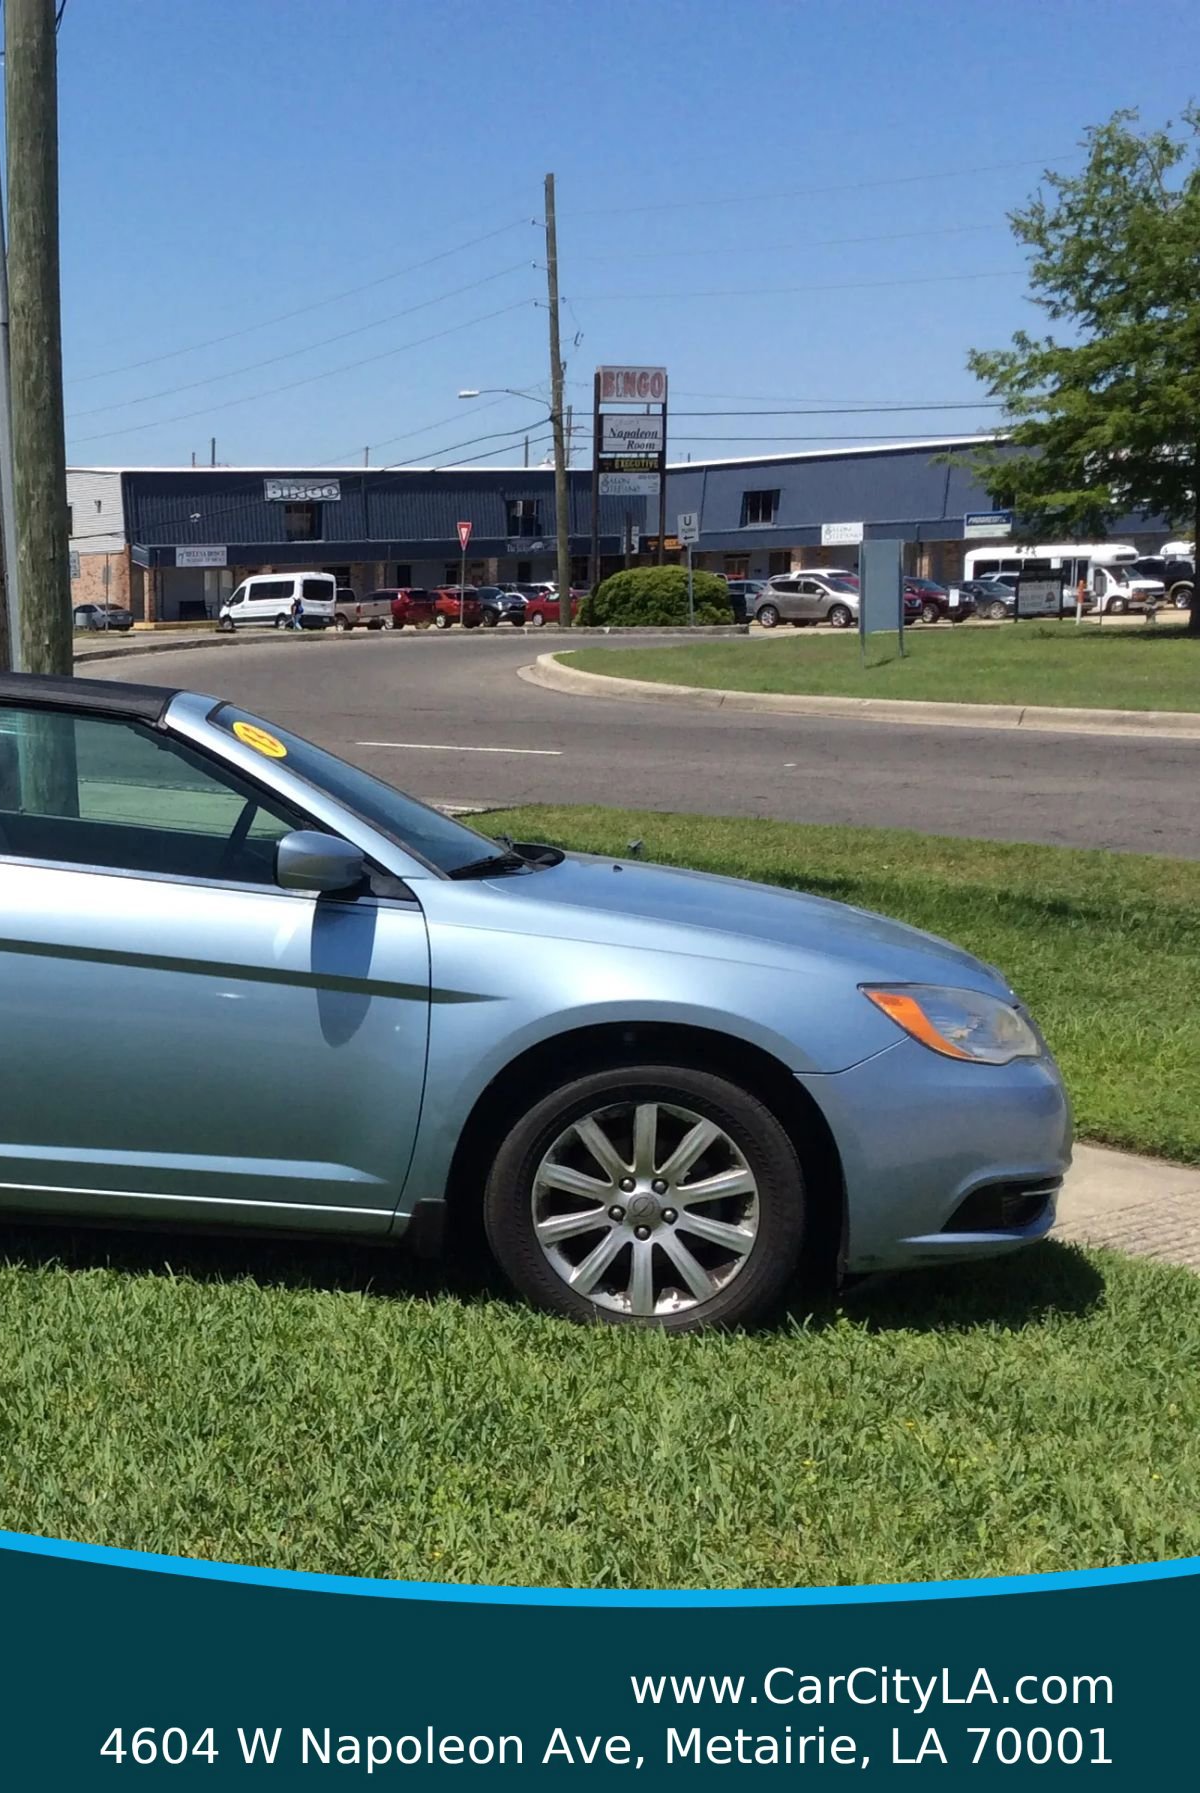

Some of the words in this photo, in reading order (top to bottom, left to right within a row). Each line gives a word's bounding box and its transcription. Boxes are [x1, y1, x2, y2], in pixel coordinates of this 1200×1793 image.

[602, 371, 664, 398] BINGO
[626, 440, 656, 449] Room
[265, 481, 339, 499] BINGO
